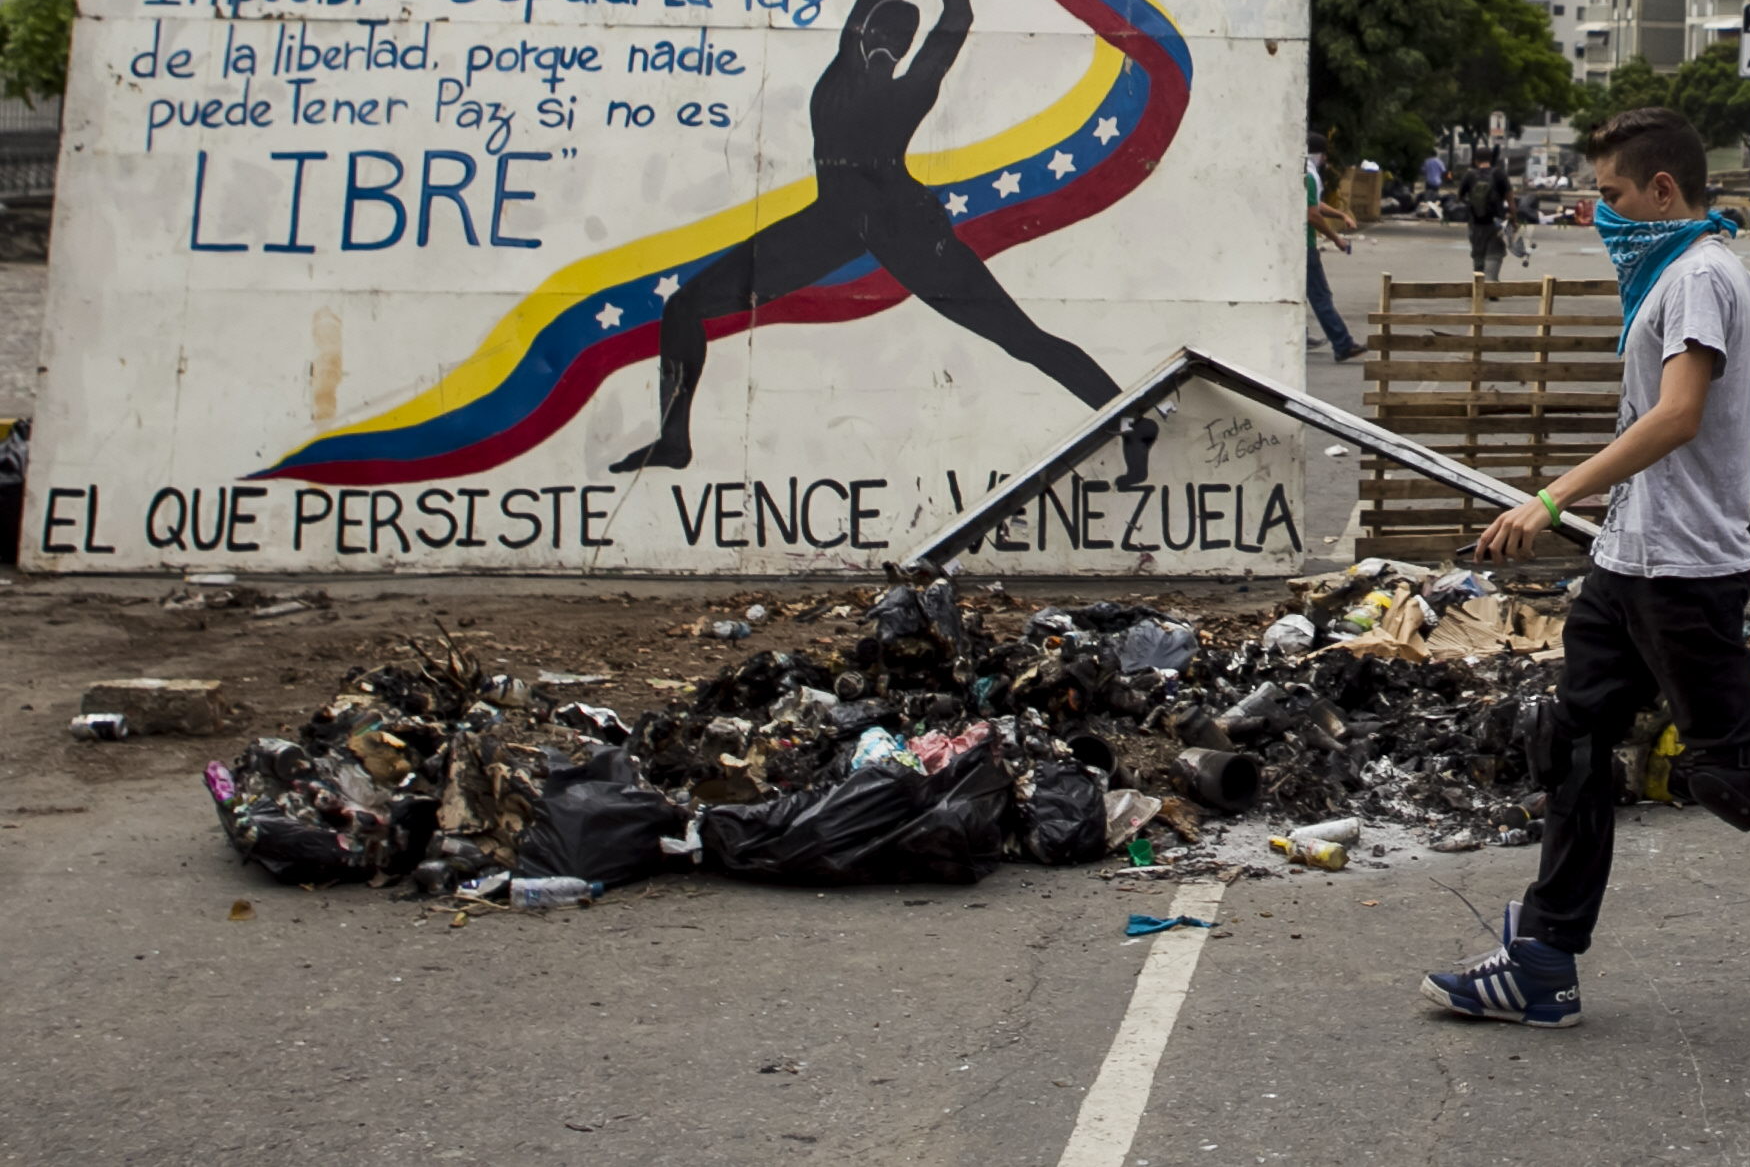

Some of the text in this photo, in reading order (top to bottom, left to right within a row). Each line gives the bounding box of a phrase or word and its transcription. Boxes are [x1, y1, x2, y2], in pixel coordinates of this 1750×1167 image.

[130, 20, 194, 78] de
[223, 23, 255, 79] la
[464, 40, 602, 93] porque
[627, 26, 746, 76] nadie
[146, 77, 272, 153] puede
[435, 77, 516, 155] Paz
[536, 95, 578, 130] si
[606, 100, 655, 128] no
[676, 100, 731, 128] es
[42, 483, 115, 554] EL
[146, 484, 269, 553] QUE
[294, 482, 616, 554] PERSISTE
[671, 477, 892, 550] VENCE
